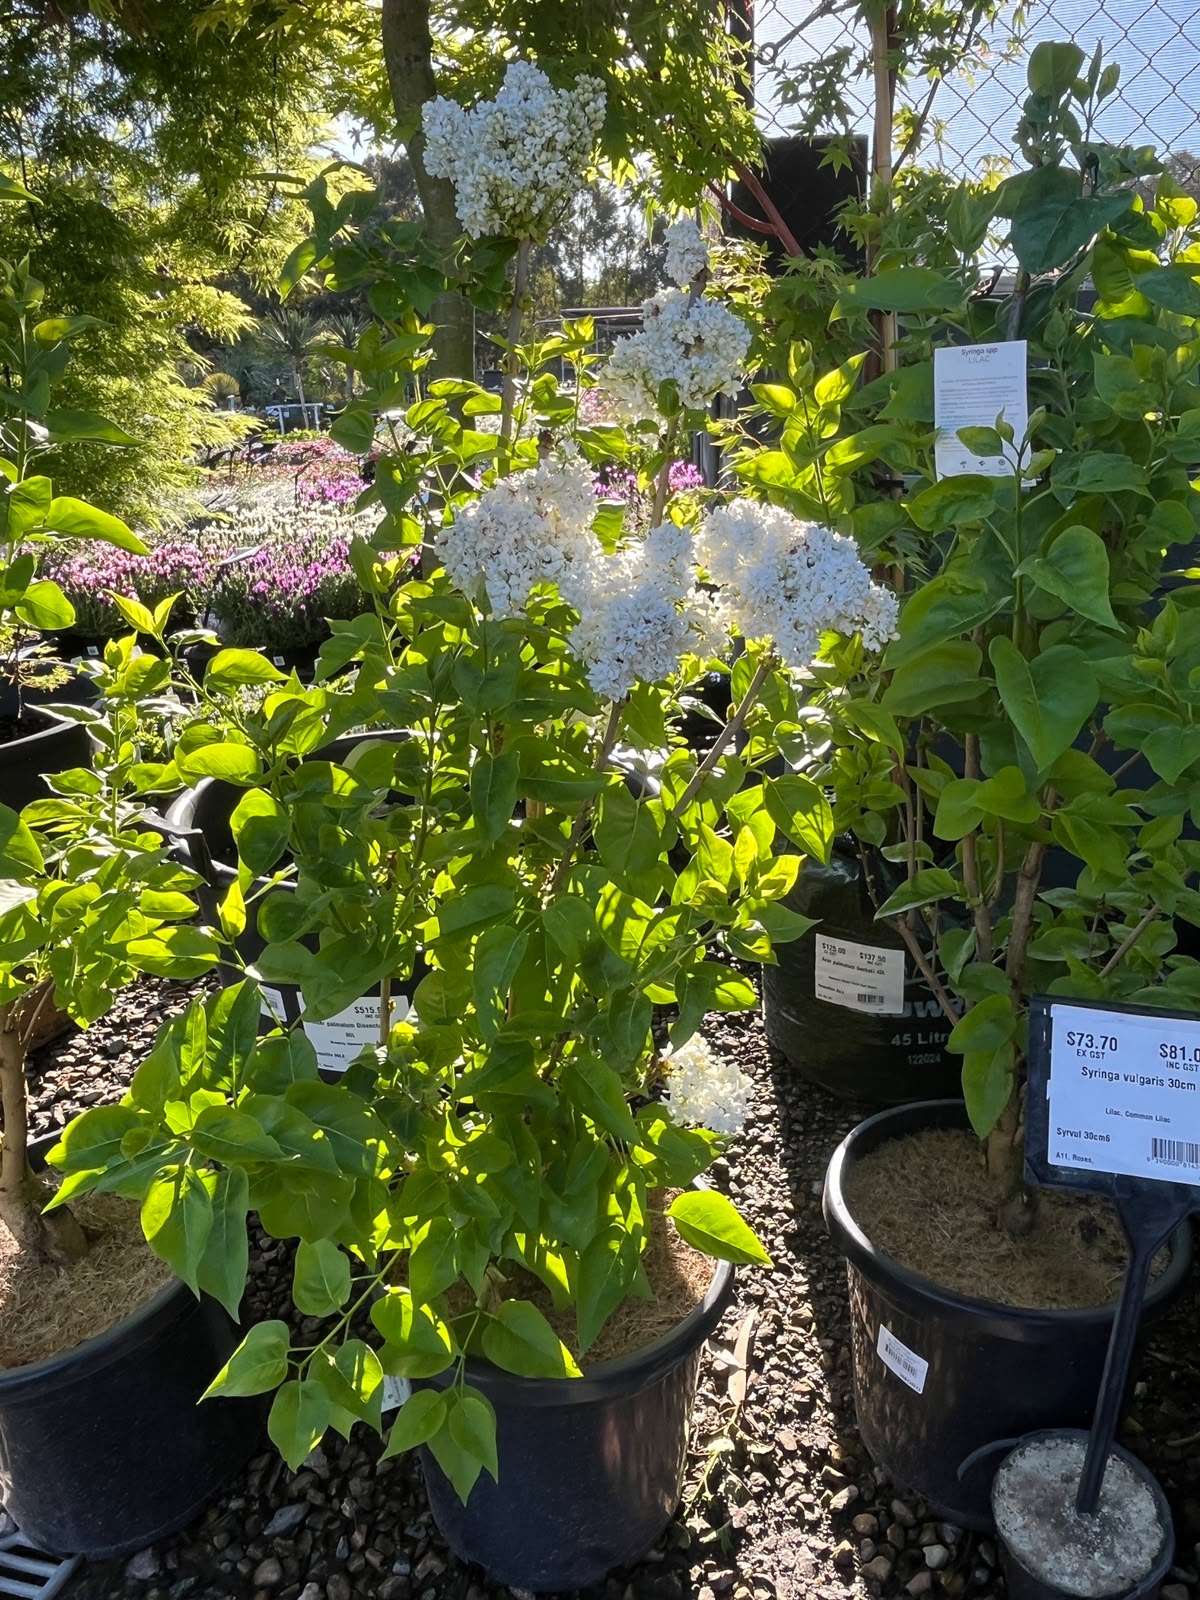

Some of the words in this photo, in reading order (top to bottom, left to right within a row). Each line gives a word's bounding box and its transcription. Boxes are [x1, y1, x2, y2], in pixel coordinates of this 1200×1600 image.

[961, 348, 985, 357] Syringa
[968, 355, 990, 364] LILAC
[890, 1033, 912, 1046] 45
[917, 1032, 950, 1045] Litr
[1067, 1031, 1118, 1052] $73.70
[1159, 1043, 1200, 1063] $81.0
[907, 1053, 941, 1065] 122024
[1076, 1049, 1087, 1057] EX
[1090, 1050, 1106, 1060] GST
[1166, 1061, 1180, 1070] INC
[1183, 1063, 1200, 1072] GST
[1081, 1066, 1120, 1082] Syringa
[1123, 1073, 1165, 1087] vulgaris
[1168, 1078, 1196, 1091] 30cm
[1105, 1107, 1123, 1117] Lilac,
[1125, 1111, 1153, 1121] Common
[1155, 1115, 1171, 1123] Lilac
[1056, 1127, 1082, 1139] Syrvul
